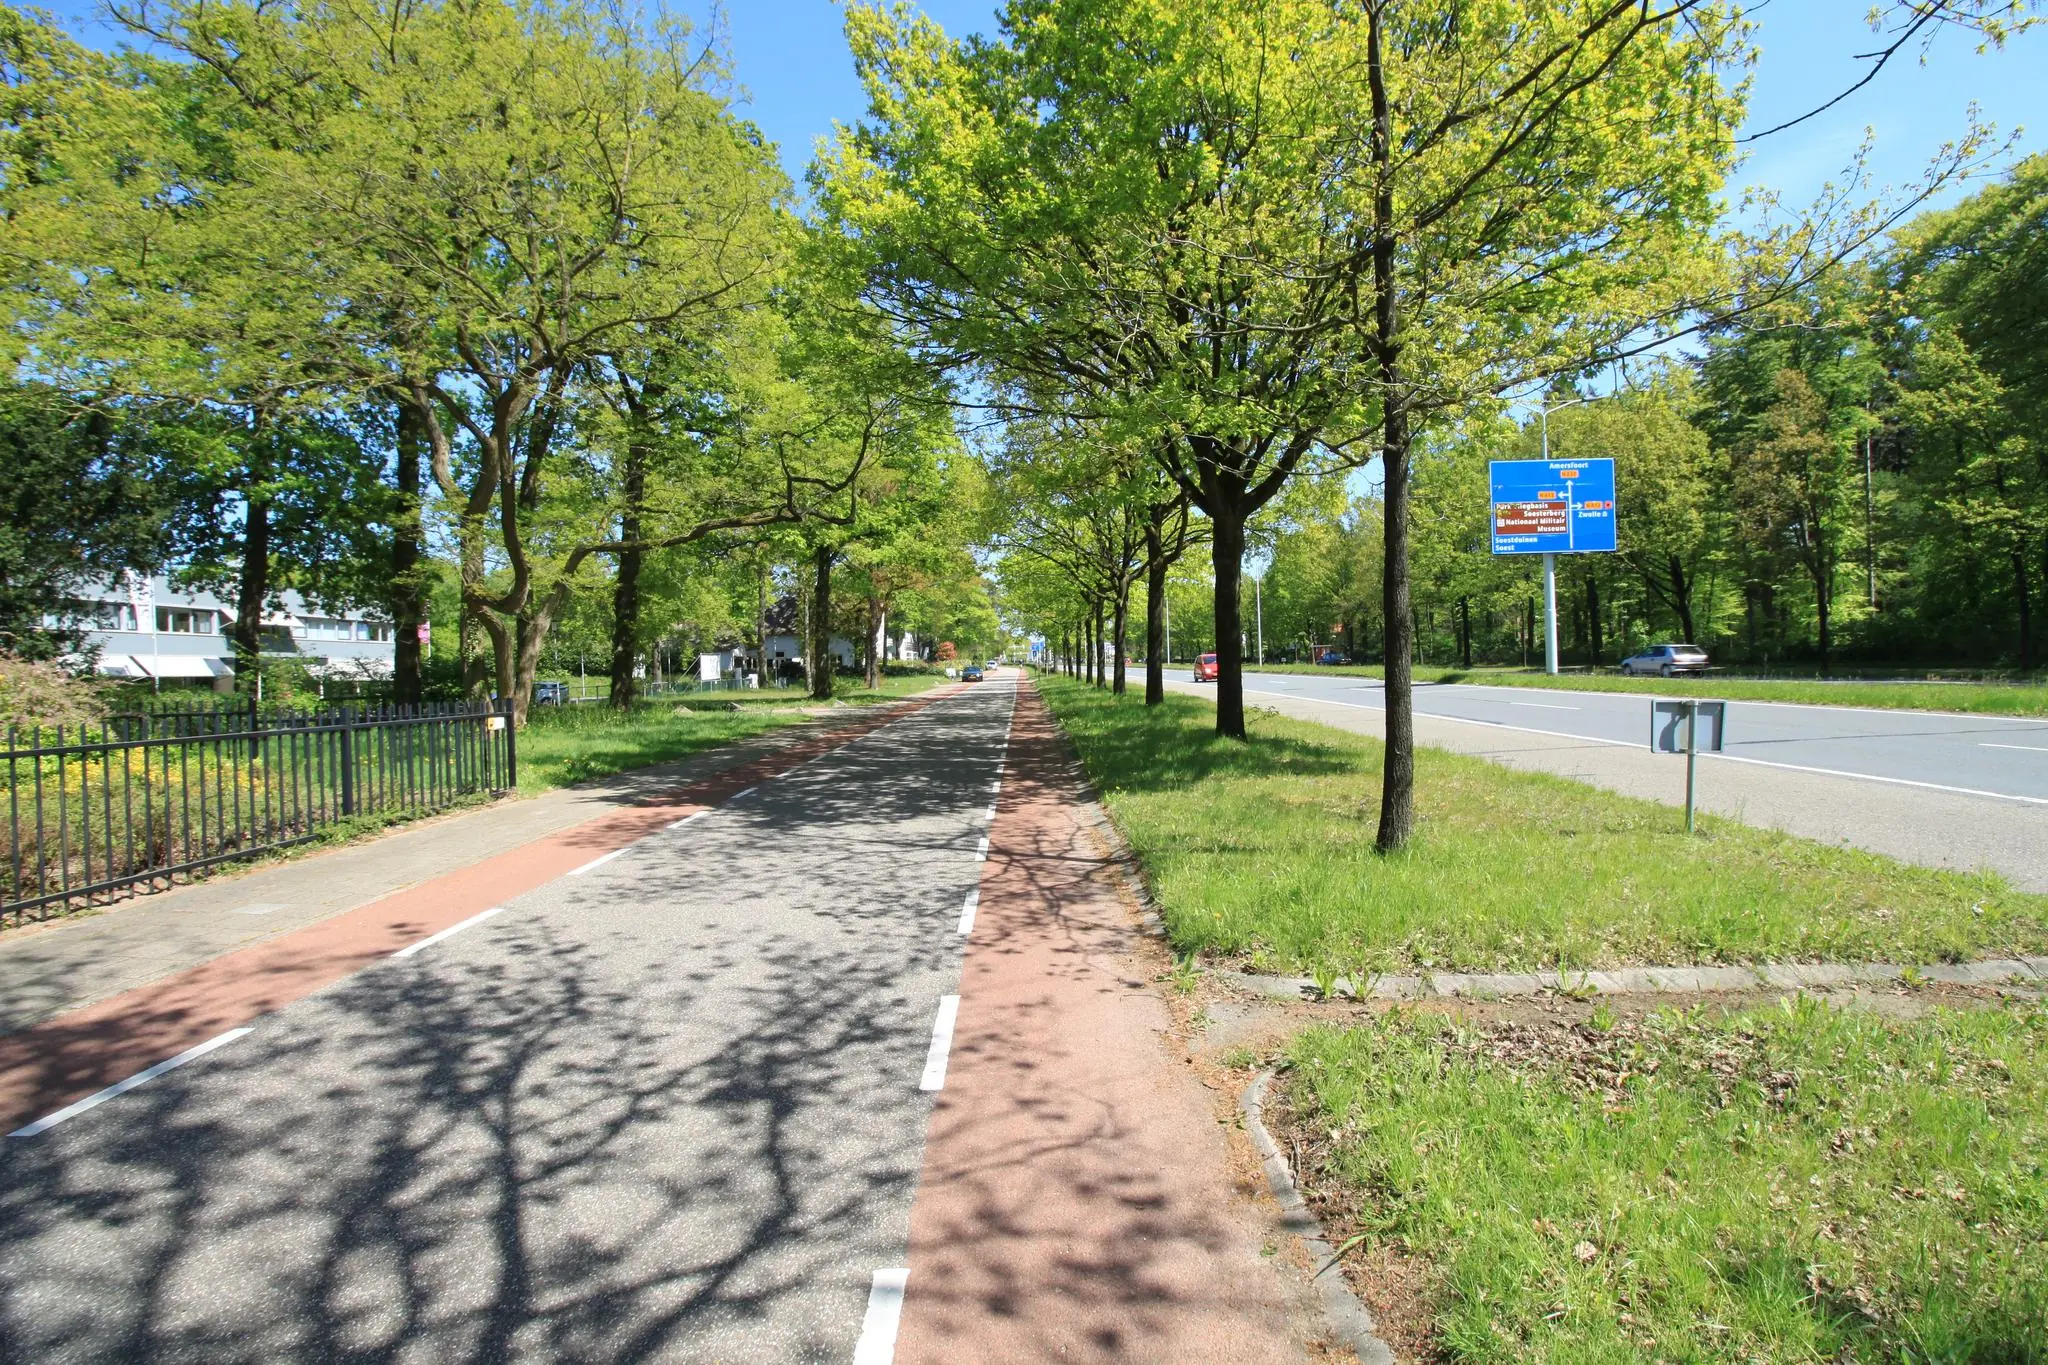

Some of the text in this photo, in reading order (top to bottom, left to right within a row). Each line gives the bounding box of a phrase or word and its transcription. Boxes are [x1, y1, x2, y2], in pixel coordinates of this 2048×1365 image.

[1523, 510, 1566, 518] Soesterberg
[1539, 517, 1566, 525] Militair
[1495, 536, 1538, 544] Soestduinen
